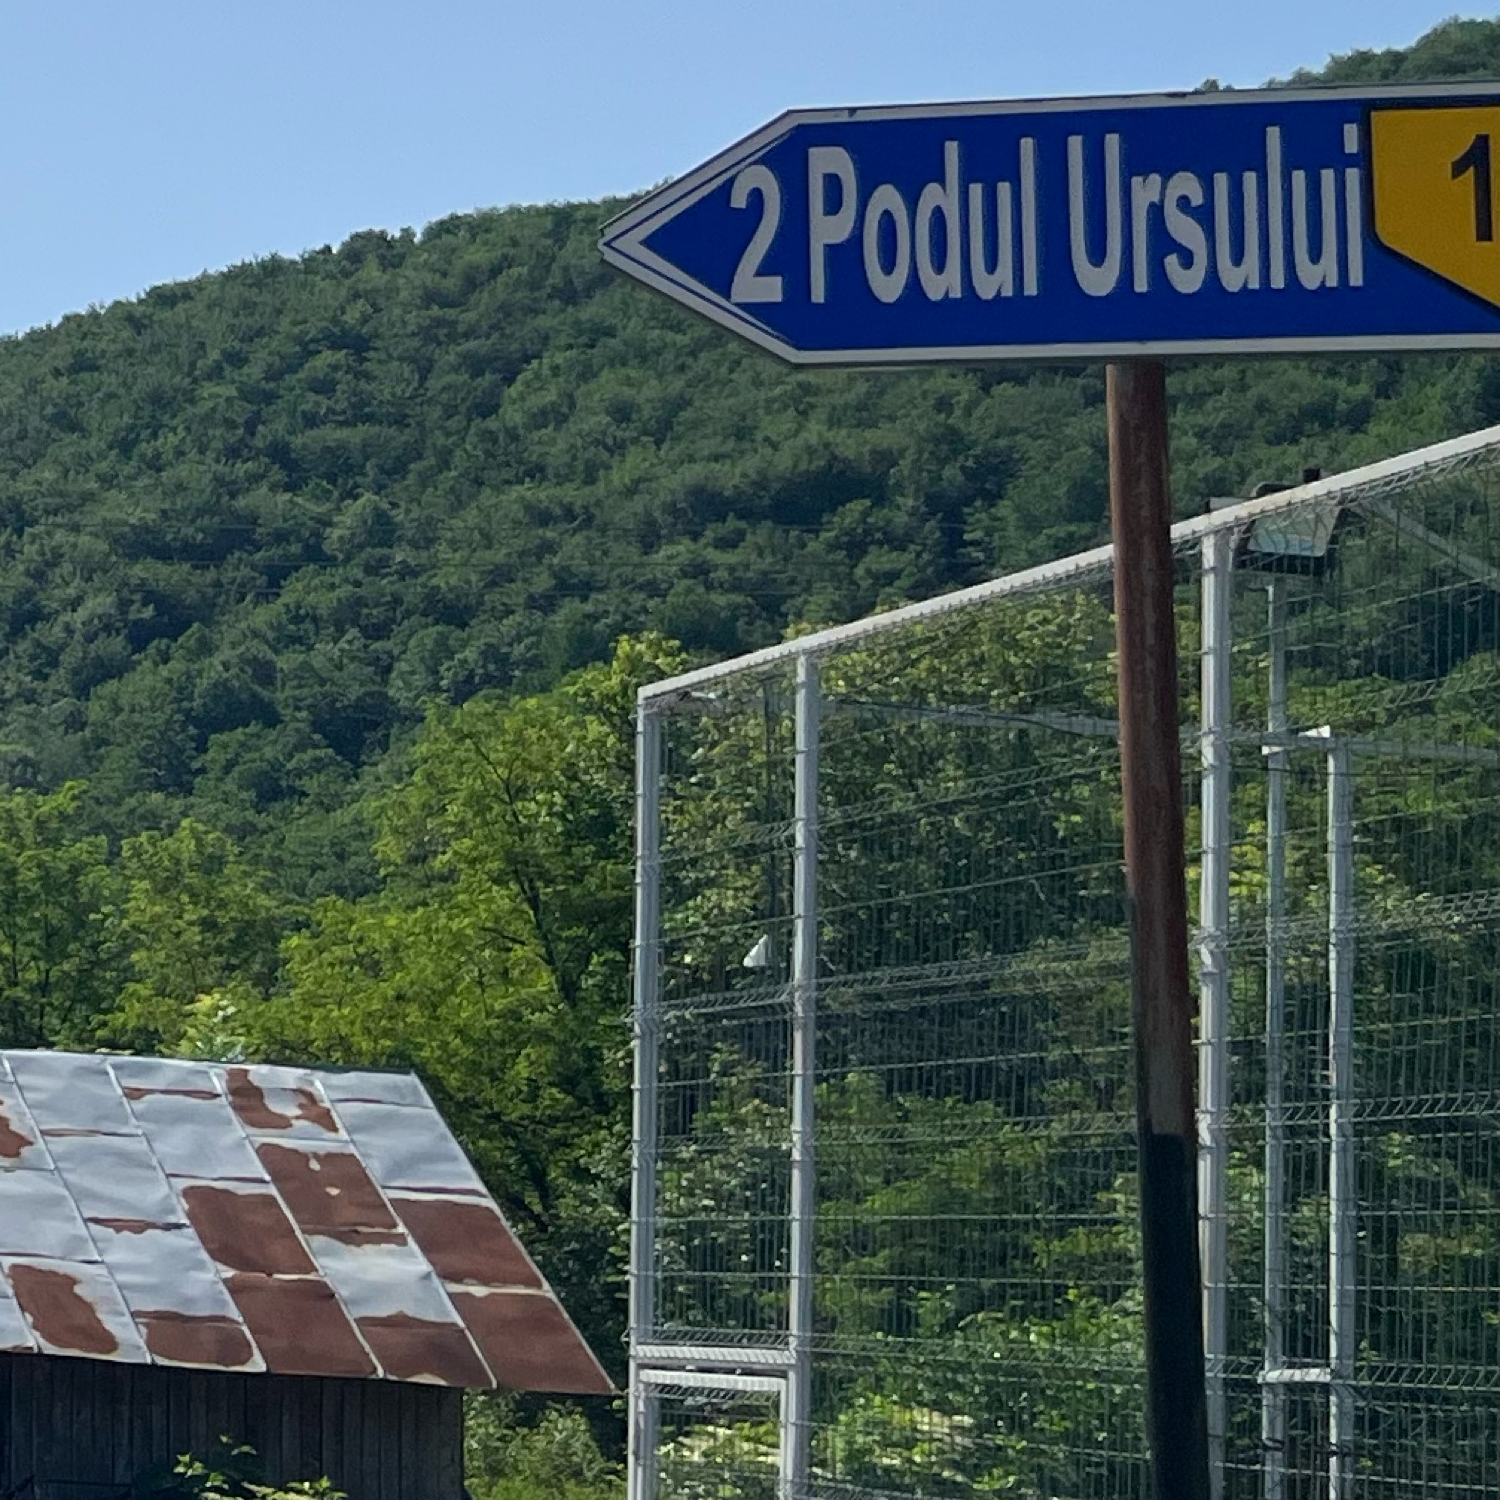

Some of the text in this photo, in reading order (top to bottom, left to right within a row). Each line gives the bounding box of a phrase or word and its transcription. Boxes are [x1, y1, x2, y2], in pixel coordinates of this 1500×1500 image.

[729, 122, 1364, 304] 2 Podul Ursului
